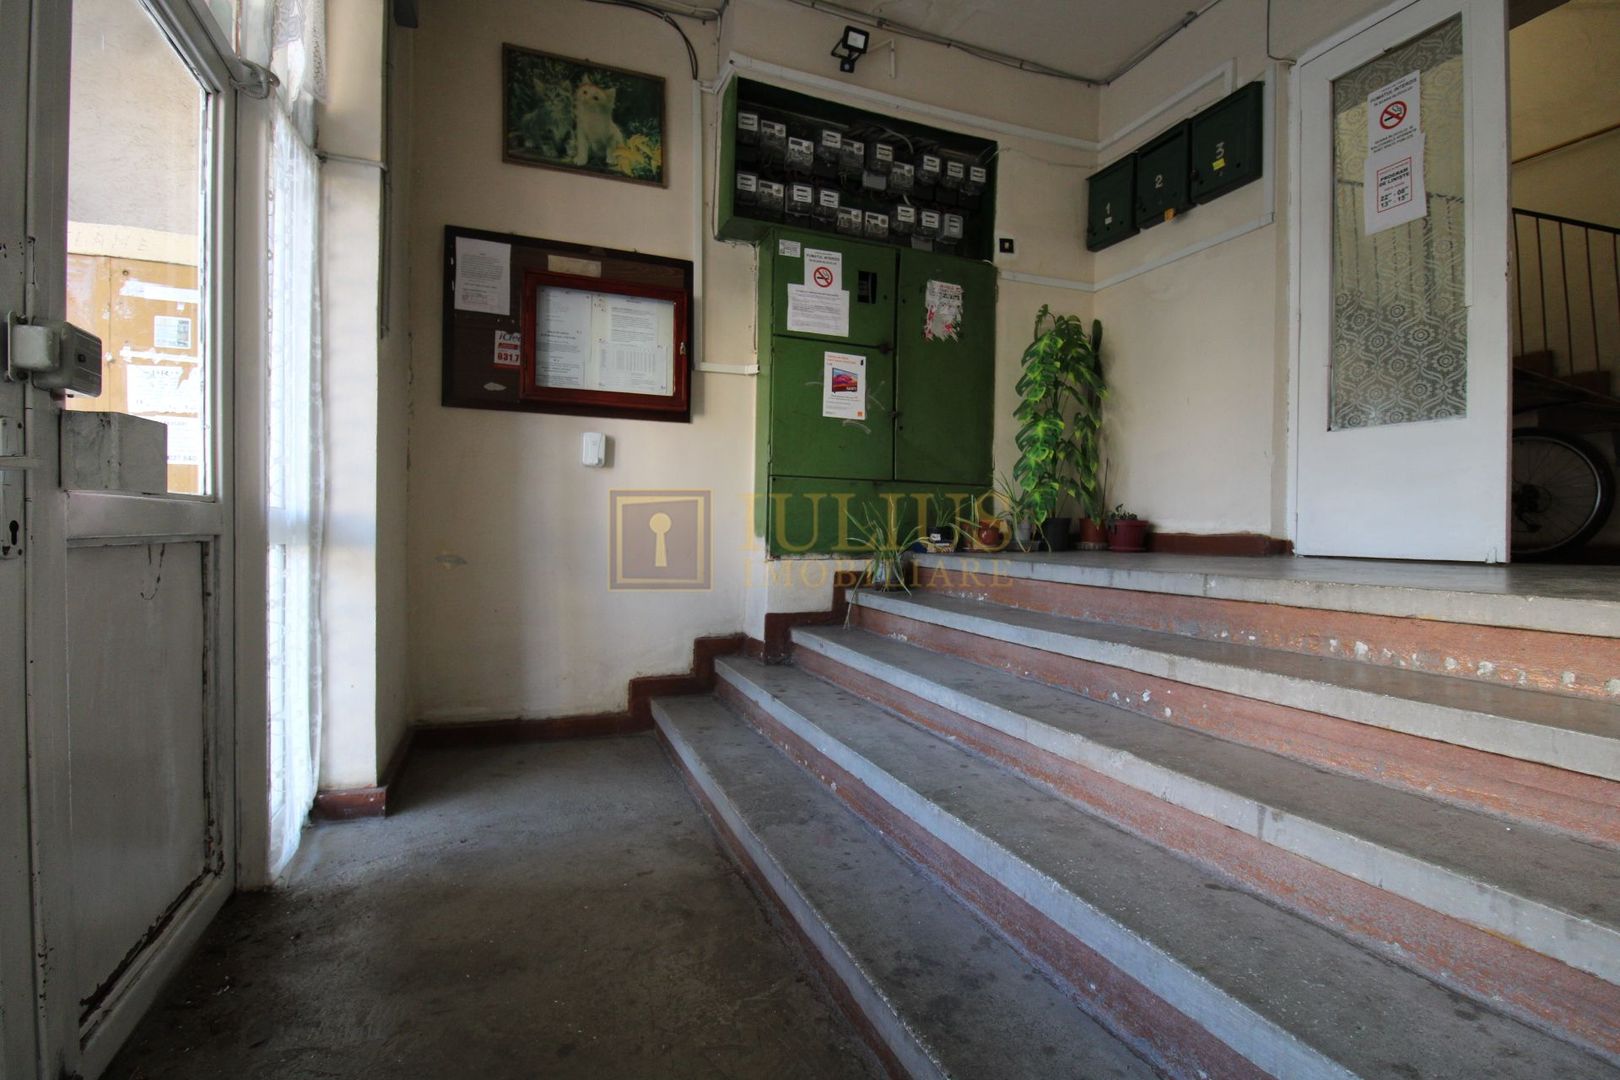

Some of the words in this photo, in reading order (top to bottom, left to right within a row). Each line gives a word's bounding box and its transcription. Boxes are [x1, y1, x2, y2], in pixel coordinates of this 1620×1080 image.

[1216, 141, 1225, 159] 3
[1380, 167, 1408, 181] PROGRAM
[1155, 174, 1164, 189] 2
[1105, 202, 1111, 215] 1
